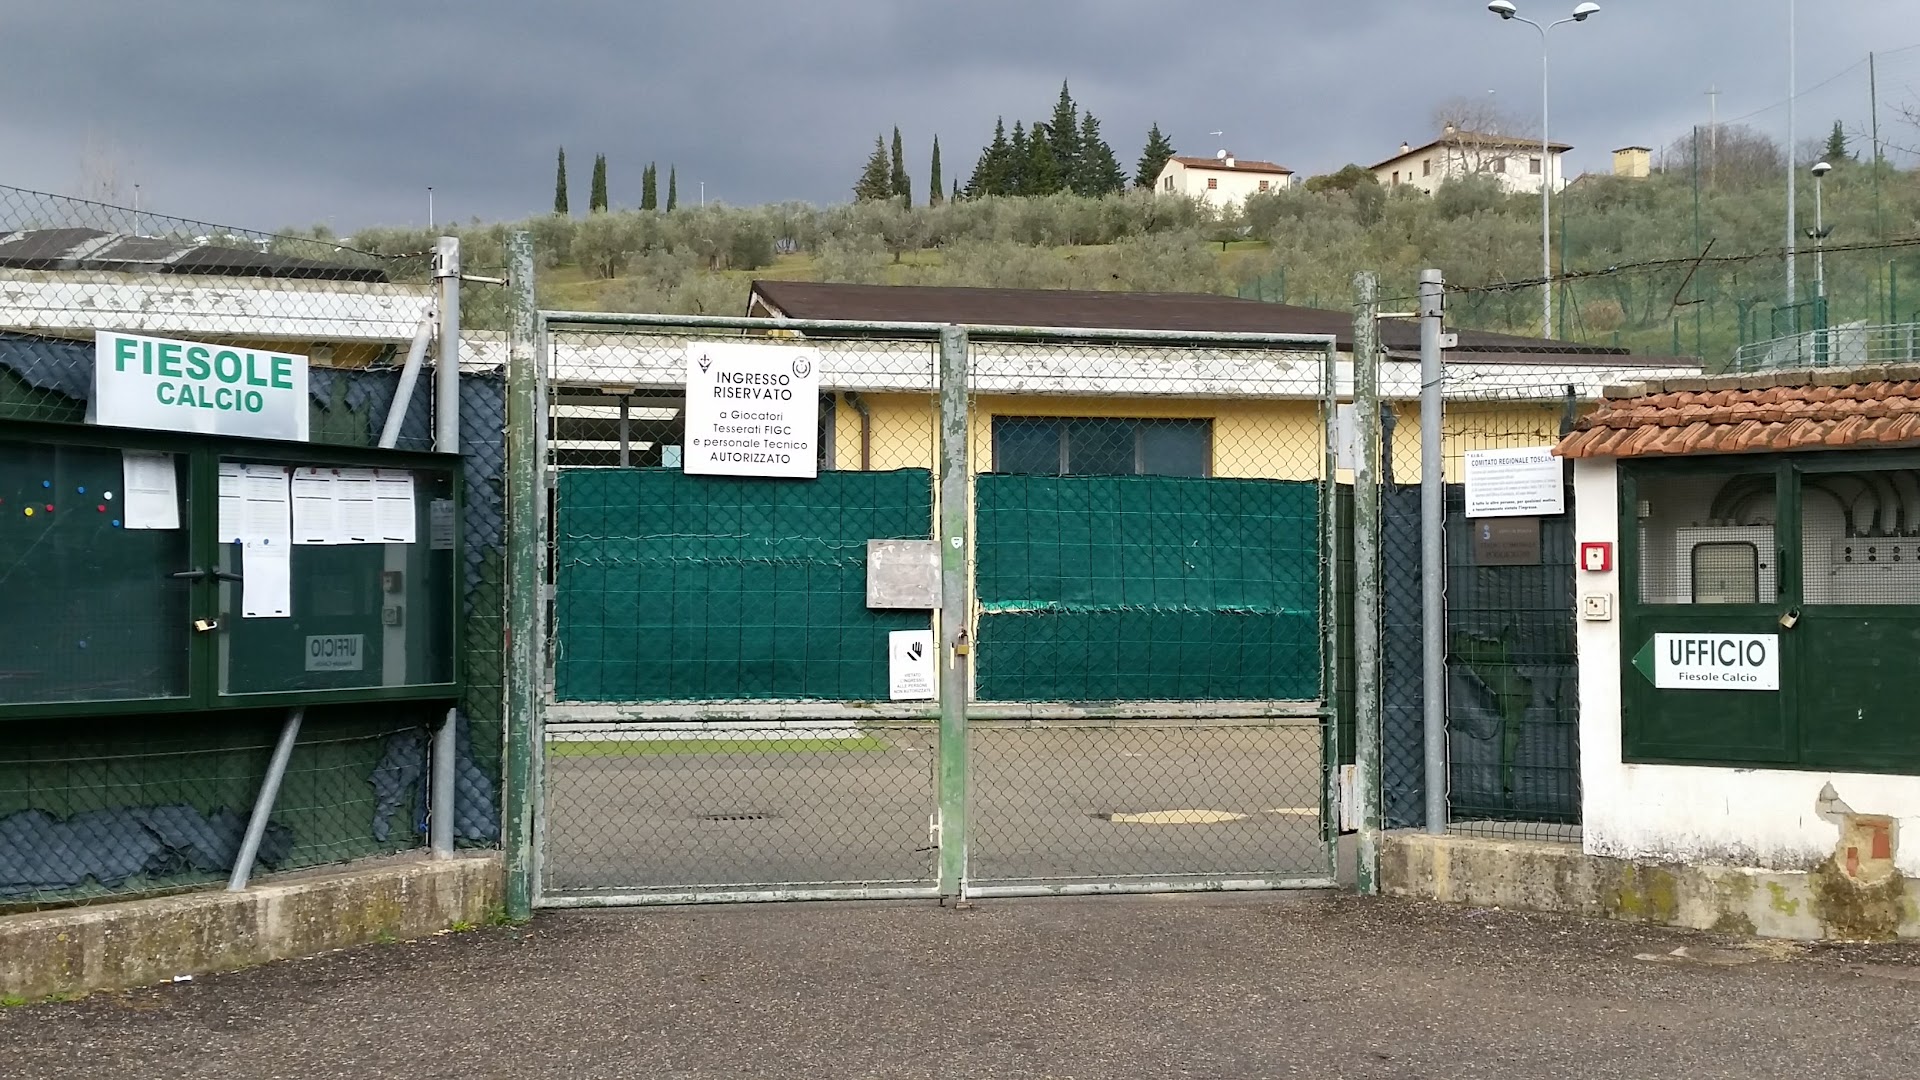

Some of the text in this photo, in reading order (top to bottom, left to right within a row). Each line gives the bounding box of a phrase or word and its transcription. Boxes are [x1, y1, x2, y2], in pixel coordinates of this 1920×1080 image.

[115, 337, 293, 389] FIESOLE
[716, 371, 790, 386] INGRESSO
[156, 381, 264, 413] CALCIO
[713, 386, 792, 401] RISERVATO
[719, 410, 784, 421] a Giocatori
[713, 423, 792, 435] Tesserati FIGC
[693, 437, 808, 450] e personale Tecnico
[709, 451, 791, 464] AUTORIZZATO
[1471, 455, 1556, 467] COMITATO REGIONALE TOSCANA
[1669, 639, 1766, 667] UFFICIO
[1679, 671, 1757, 682] Fiesole Calcio
